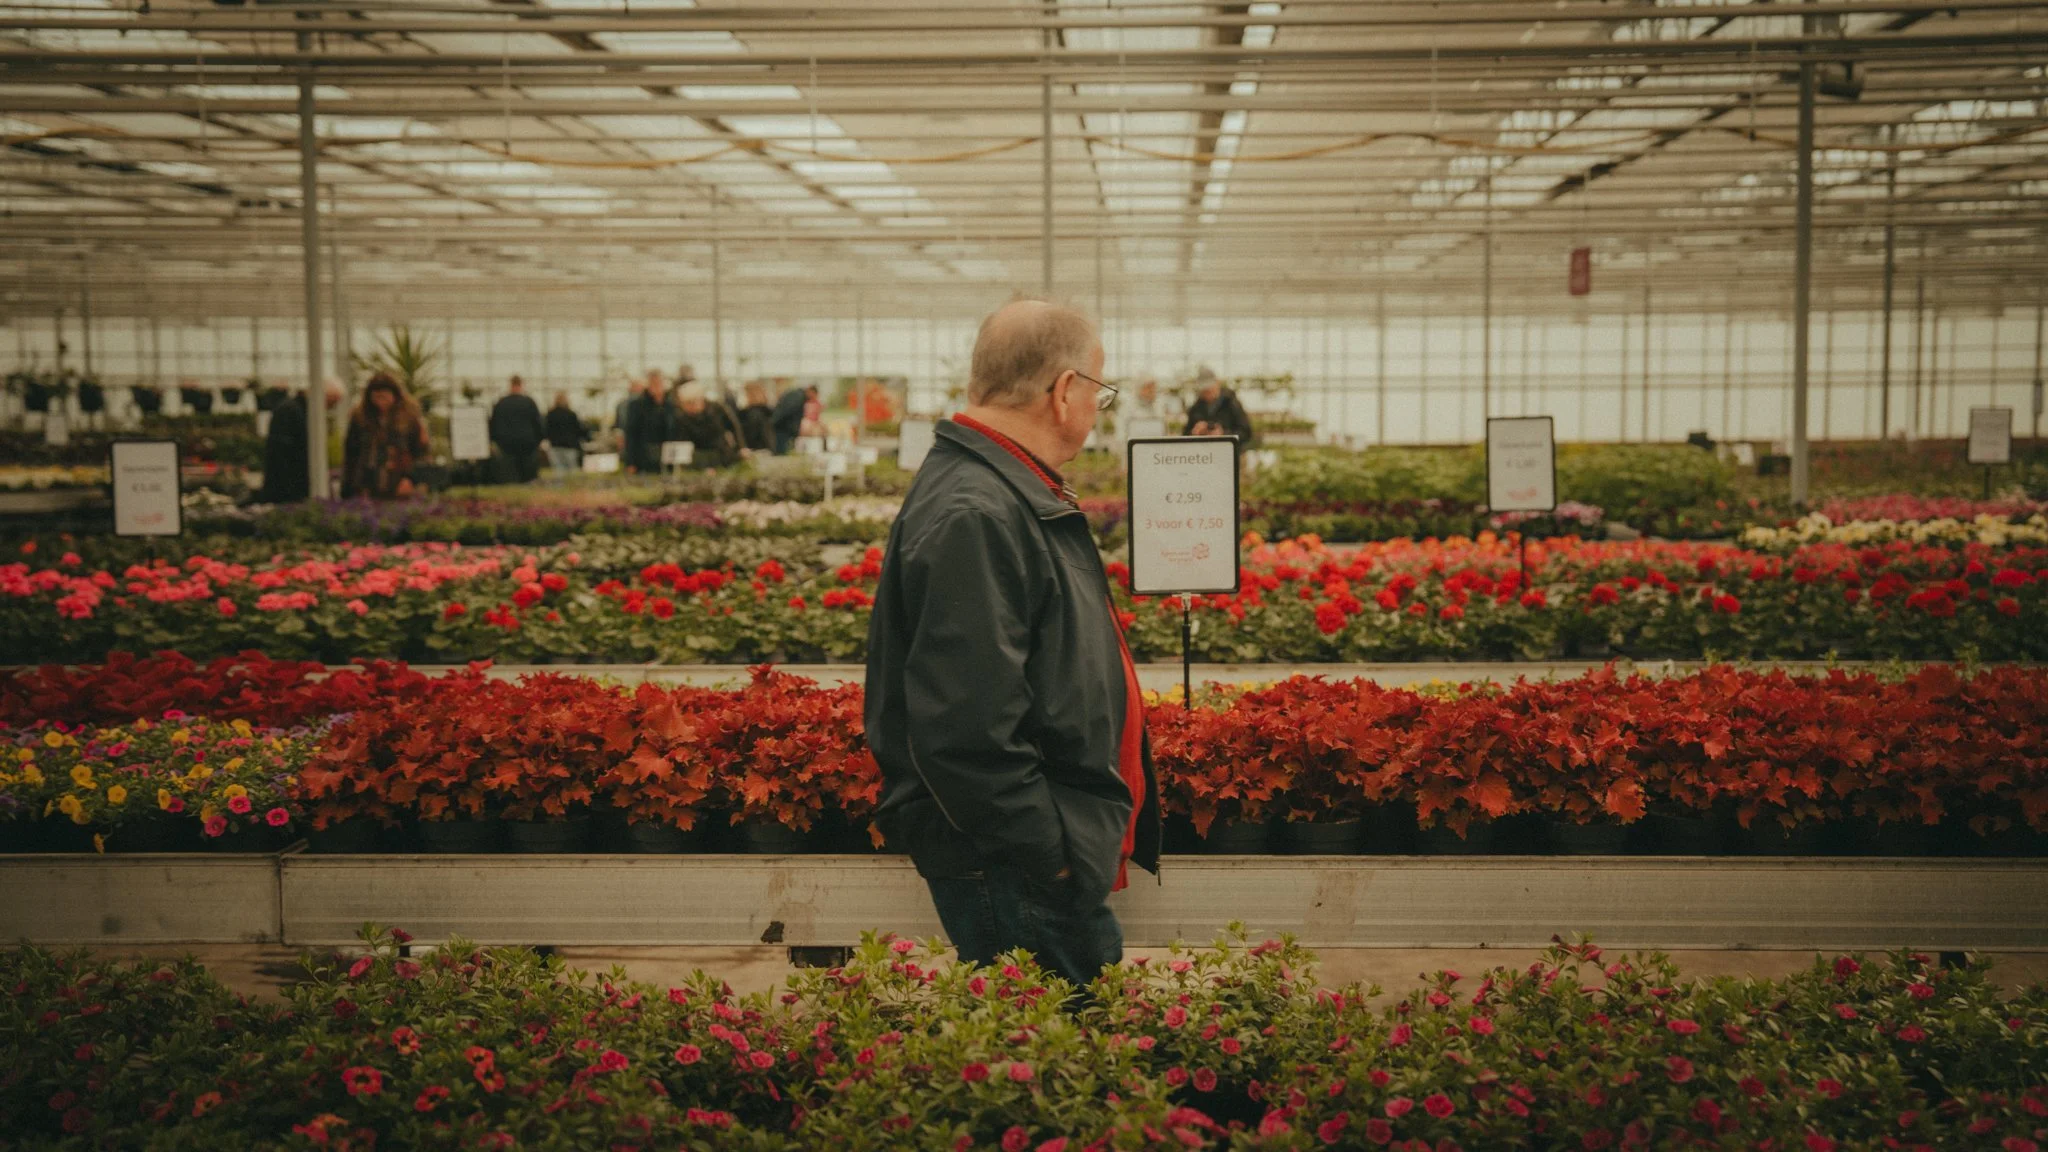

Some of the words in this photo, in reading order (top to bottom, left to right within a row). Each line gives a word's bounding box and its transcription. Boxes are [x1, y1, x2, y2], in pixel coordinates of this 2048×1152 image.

[1153, 452, 1213, 465] Siernetel
[1175, 492, 1202, 504] 2,99
[1144, 518, 1152, 529] 3
[1155, 520, 1182, 529] voor
[1186, 518, 1194, 529] €
[1198, 517, 1224, 529] 7,50
